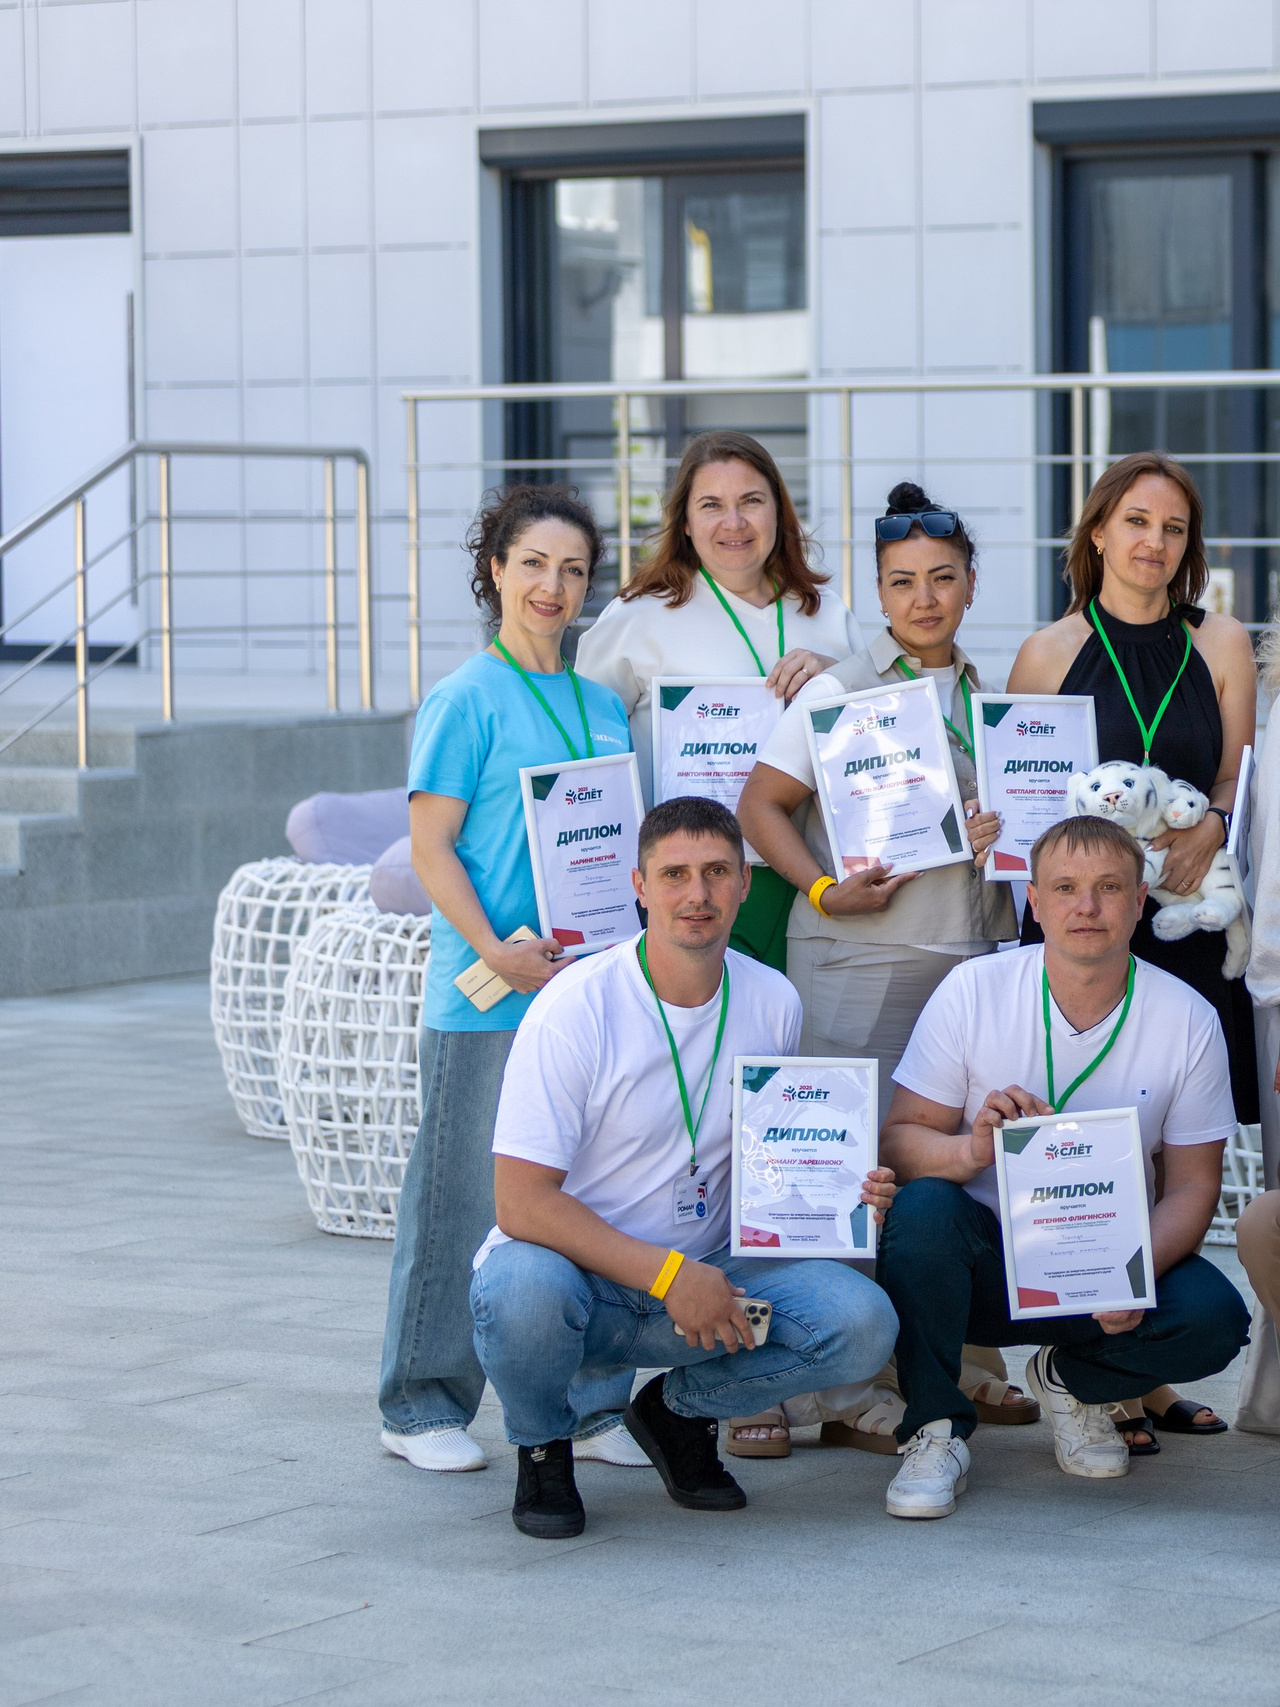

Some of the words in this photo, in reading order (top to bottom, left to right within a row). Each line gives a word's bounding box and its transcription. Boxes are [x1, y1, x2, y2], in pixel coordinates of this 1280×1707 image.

[710, 705, 741, 716] СЛЁТ
[866, 716, 897, 731] СЛЁТ
[1029, 723, 1056, 735] СЛЁТ
[680, 742, 758, 757] ДИПЛОМ
[844, 747, 921, 777] ДИПЛОМ
[1003, 759, 1074, 774] ДИПЛОМ
[577, 788, 603, 801] СЛЁТ
[850, 787, 872, 797] АСЕЛЬ
[556, 822, 622, 848] ДИПЛОМ
[569, 855, 595, 866] МАРИНЕ
[594, 852, 617, 862] НЕГРИЙ
[797, 1088, 830, 1100] СЛЁТ
[762, 1127, 848, 1143] ДИПЛОМ
[1059, 1143, 1093, 1156] СЛЁТ
[1030, 1180, 1115, 1204] ДИПЛОМ
[677, 1203, 695, 1212] РОМАН
[1033, 1215, 1068, 1225] ЕВГЕНИЮ
[1067, 1211, 1117, 1222] ФЛИГИНСКИХ
